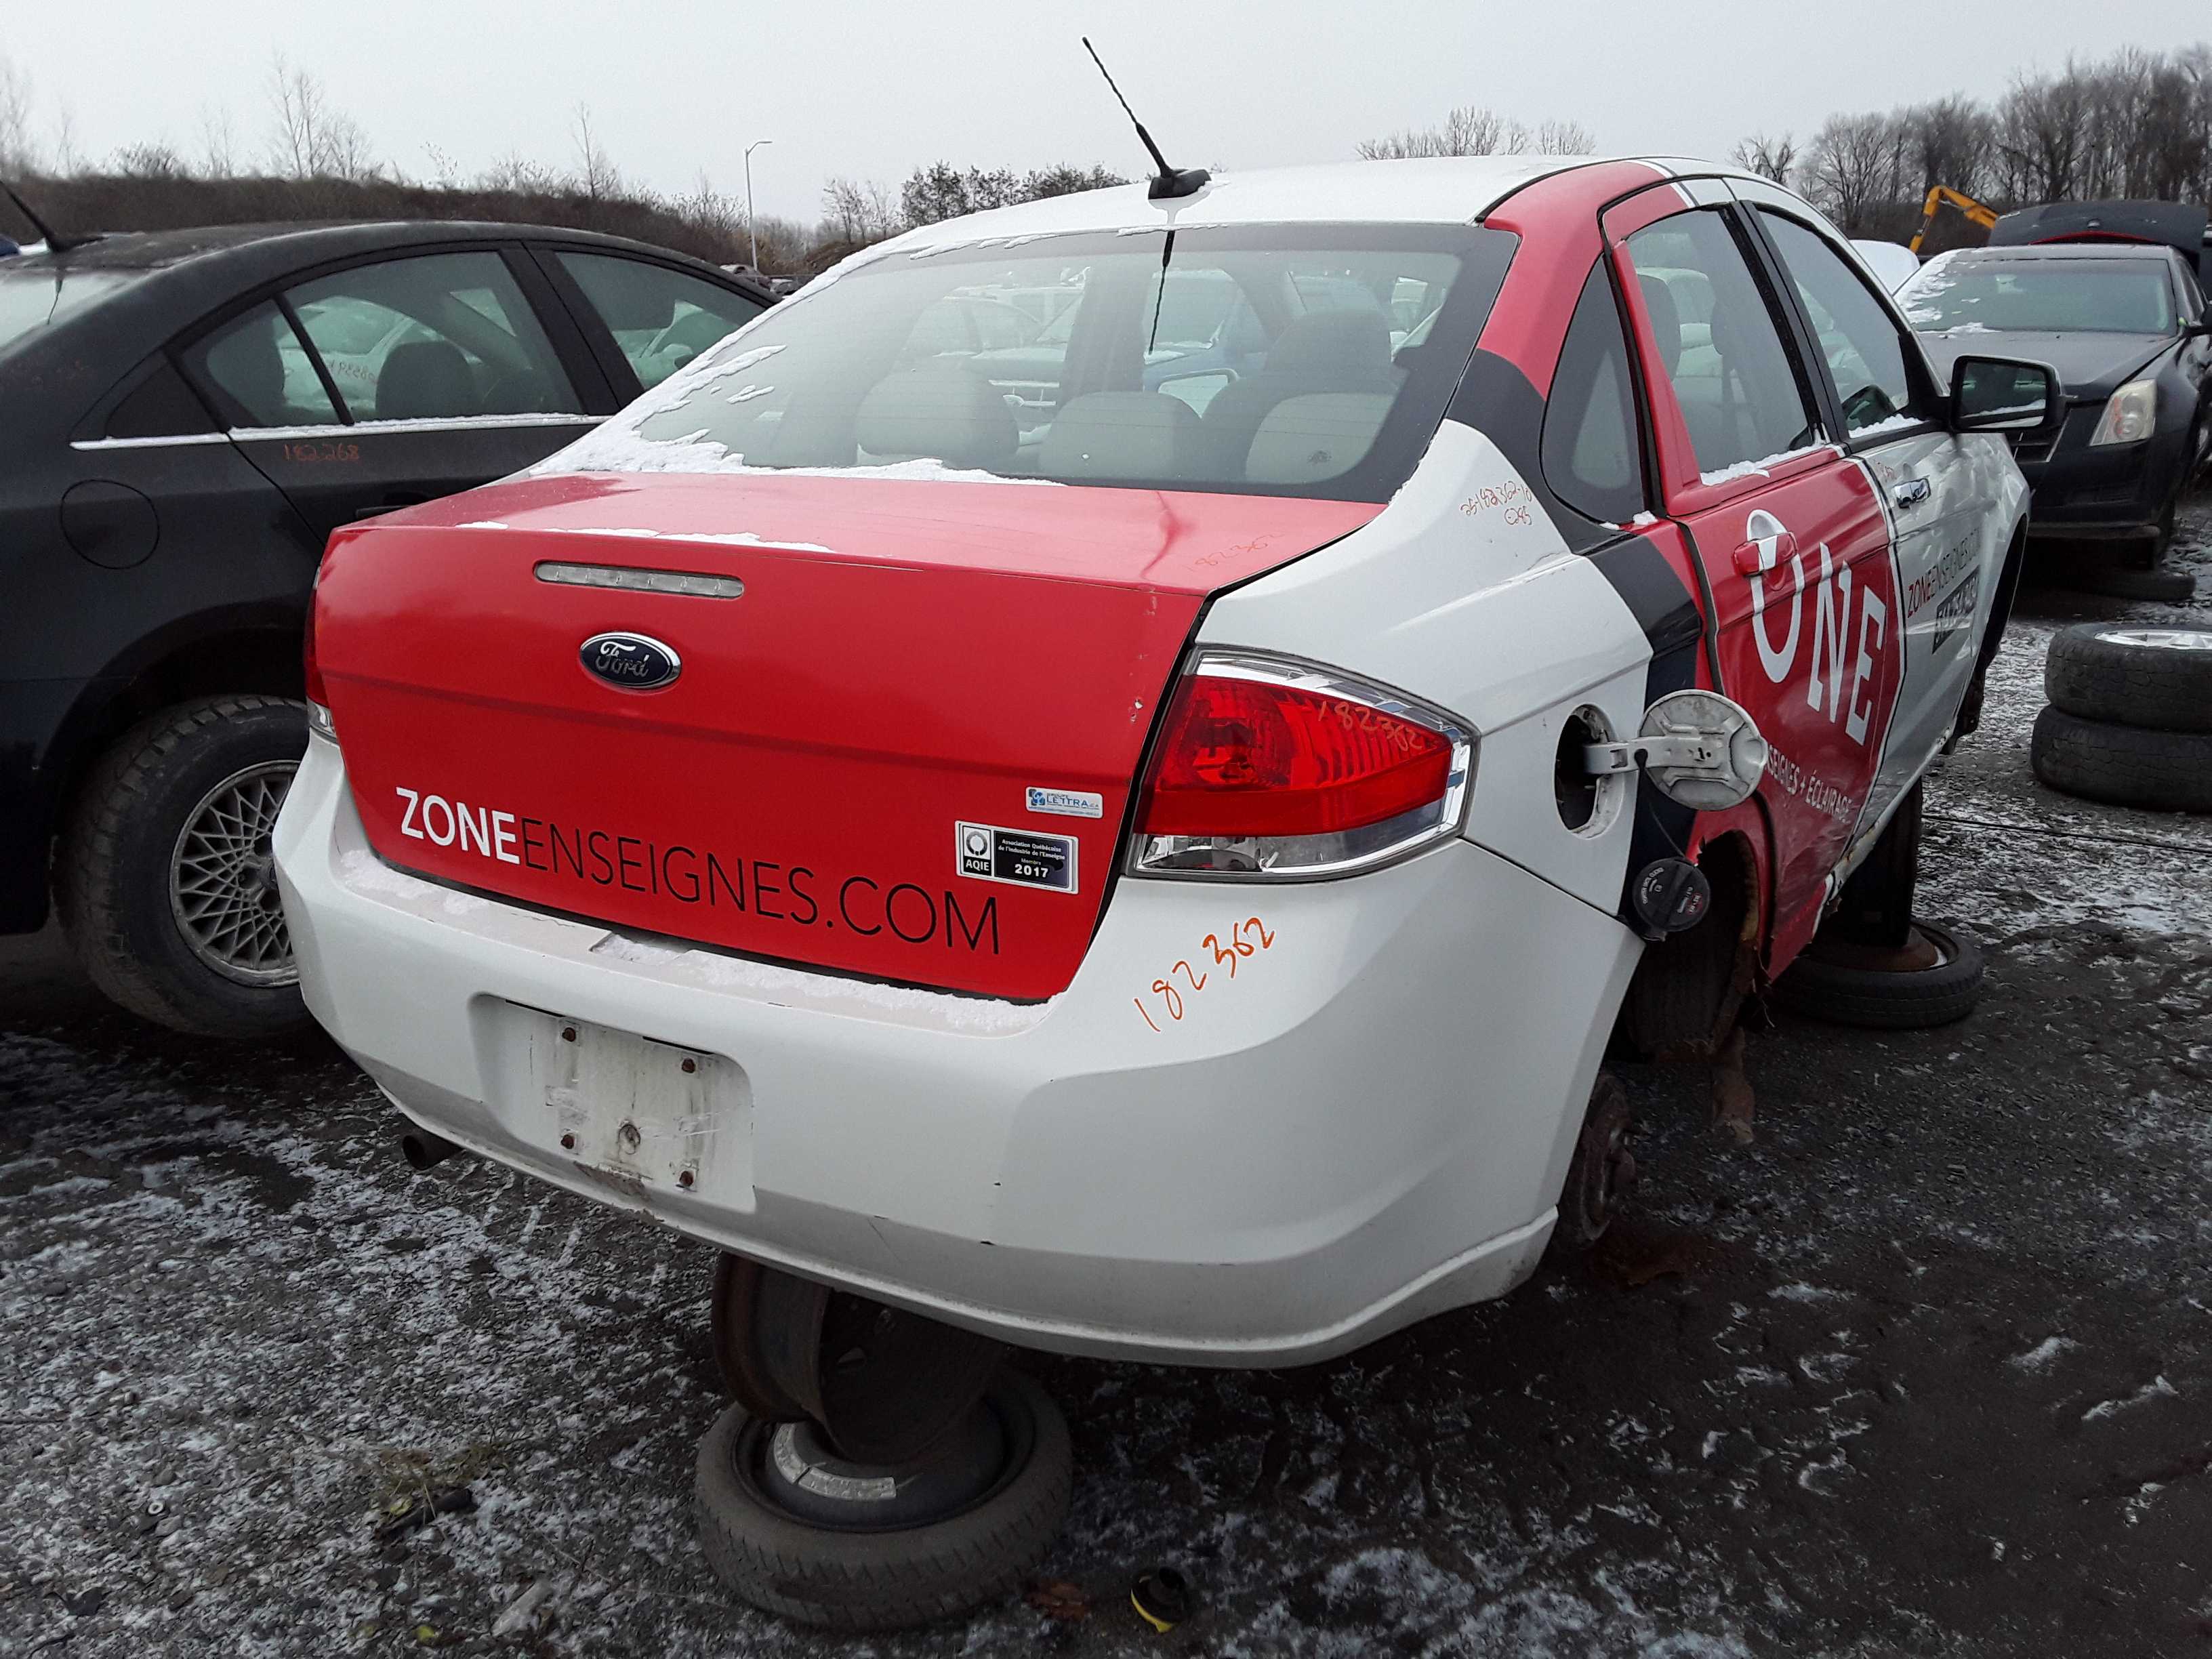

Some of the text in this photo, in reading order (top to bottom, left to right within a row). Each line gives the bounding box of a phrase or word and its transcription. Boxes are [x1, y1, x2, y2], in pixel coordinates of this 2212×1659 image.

[595, 641, 649, 677] Ford
[1317, 700, 1422, 752] 182362
[1002, 838, 1062, 853] Association Québécoise
[965, 859, 990, 872] AQIE
[1021, 857, 1042, 865] Membre
[1015, 864, 1048, 878] 2017
[1133, 917, 1275, 1032] 182362
